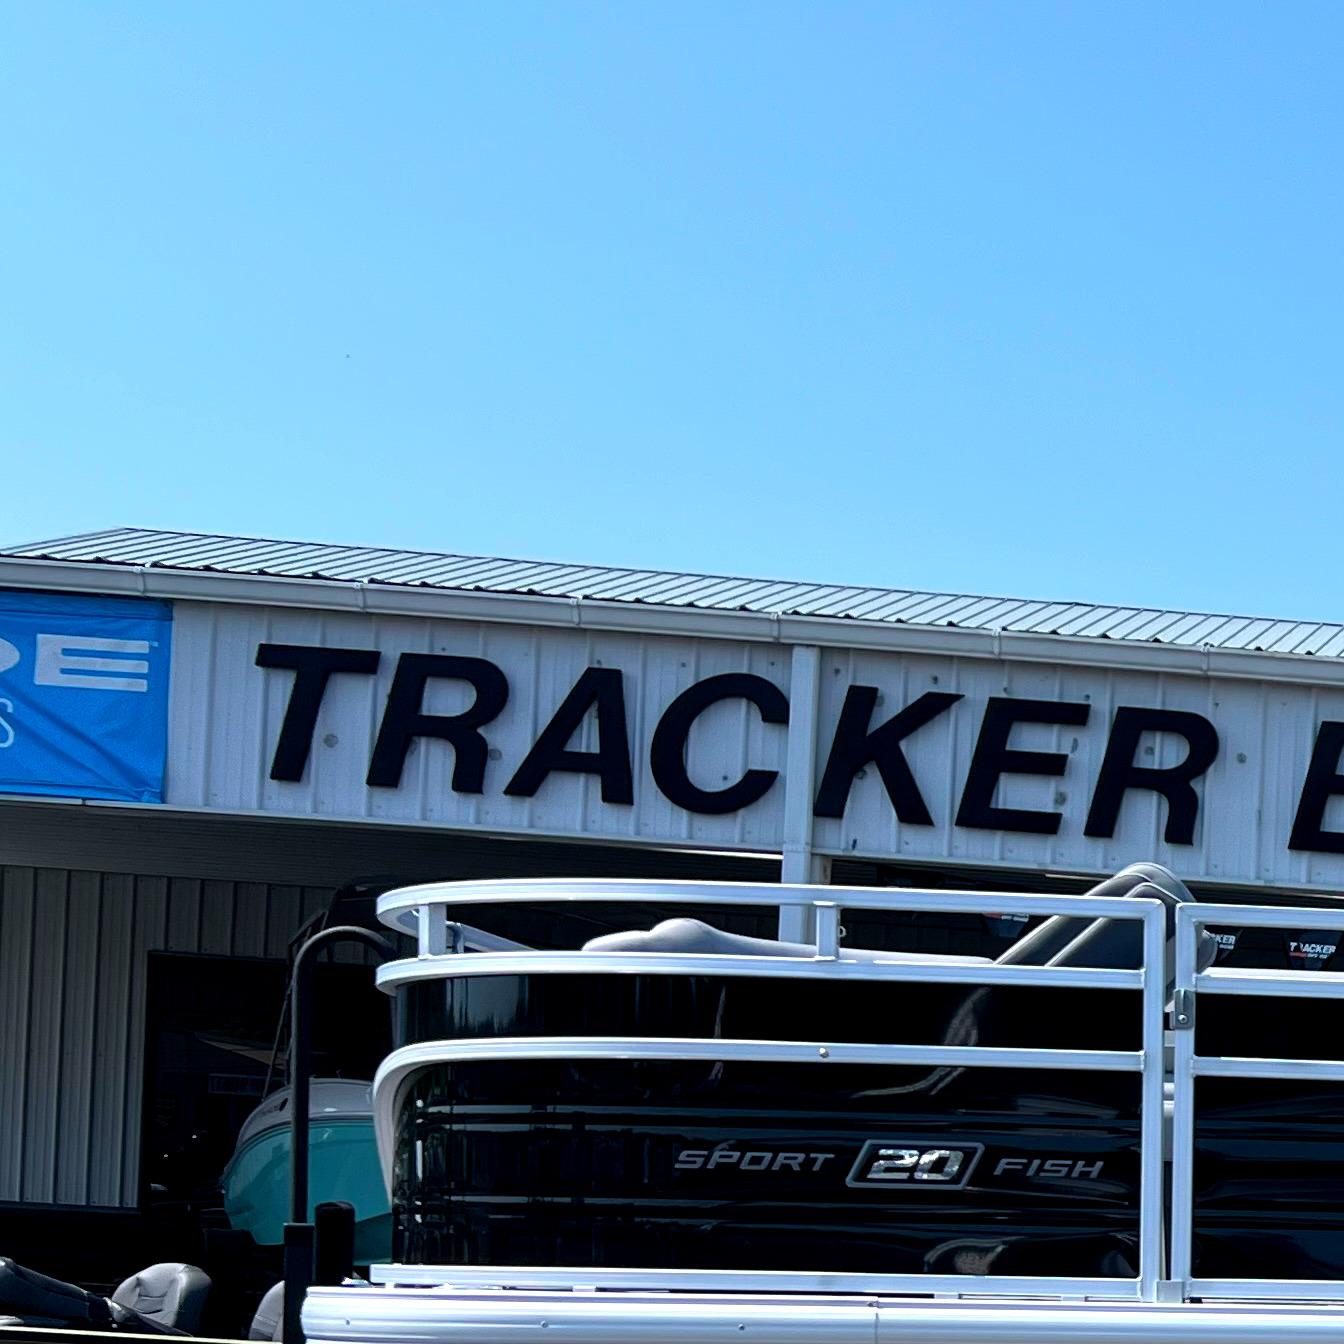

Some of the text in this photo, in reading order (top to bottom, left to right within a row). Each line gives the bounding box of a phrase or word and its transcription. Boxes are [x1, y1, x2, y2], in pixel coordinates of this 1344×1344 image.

[255, 643, 1219, 846] TRACKER
[674, 1149, 1104, 1180] SPORT 20 FISH
